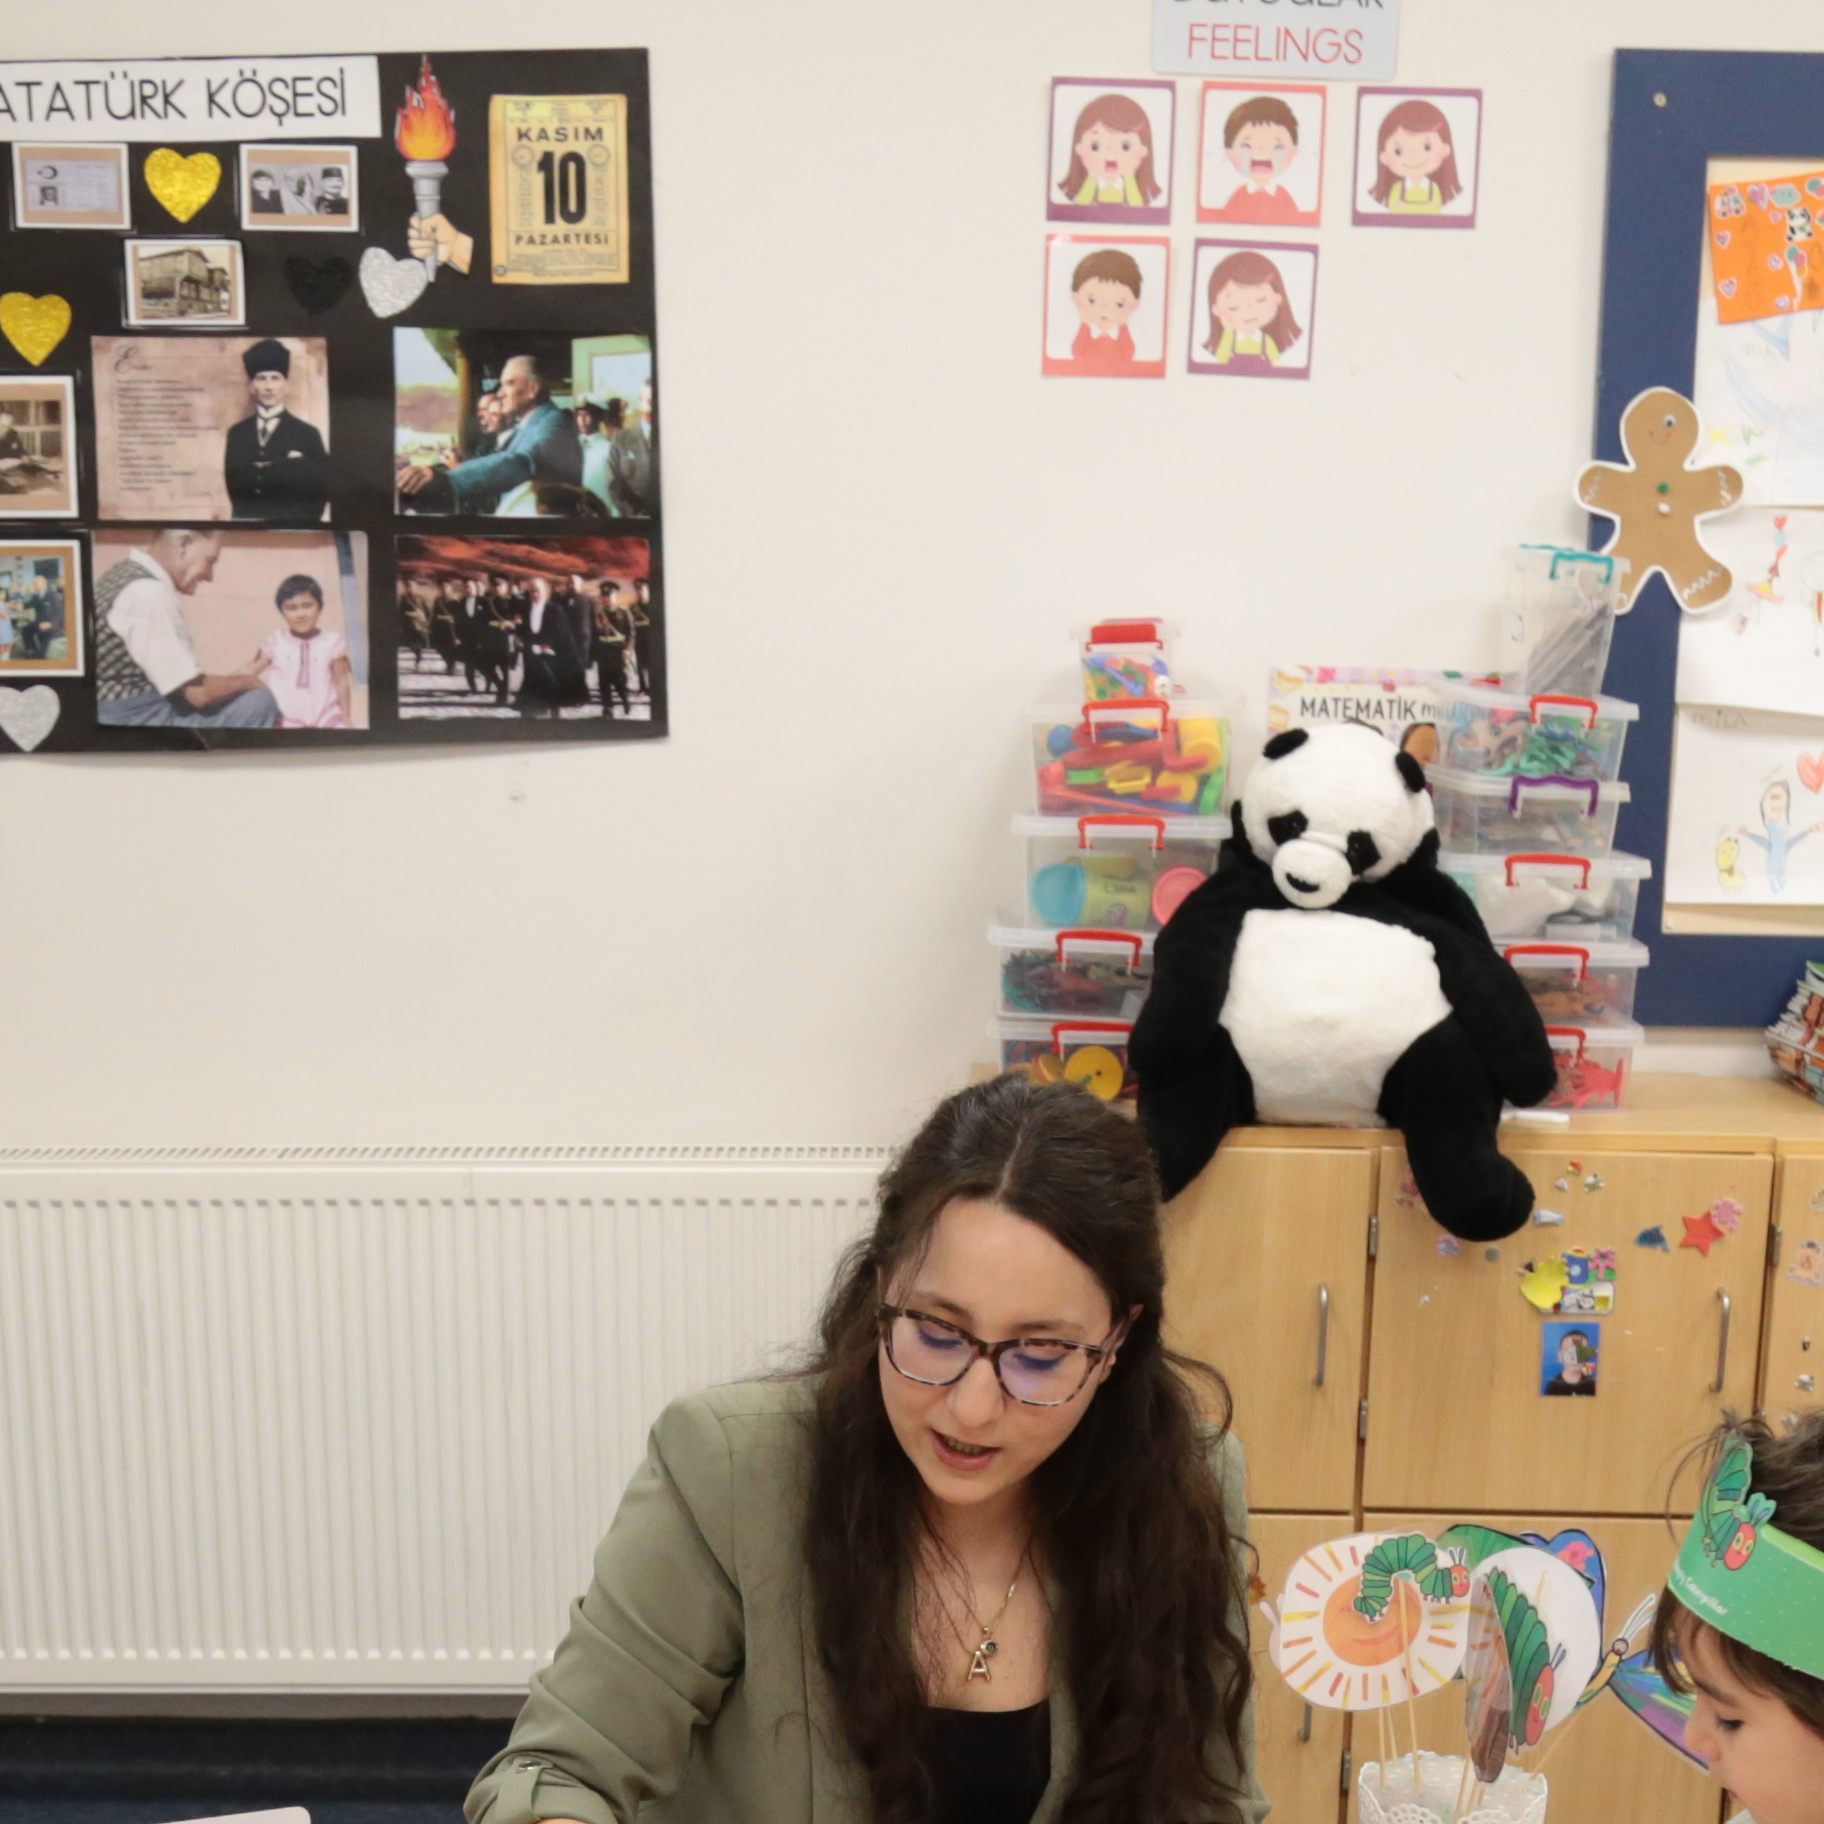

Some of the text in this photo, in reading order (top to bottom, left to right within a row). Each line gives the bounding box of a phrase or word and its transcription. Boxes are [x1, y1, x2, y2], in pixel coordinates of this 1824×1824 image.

[1188, 23, 1364, 64] FEELINGS
[207, 68, 346, 127] KÖŞESİ
[517, 127, 604, 142] KASIM
[537, 151, 586, 224] 10
[1300, 695, 1417, 722] MATEMATİK
